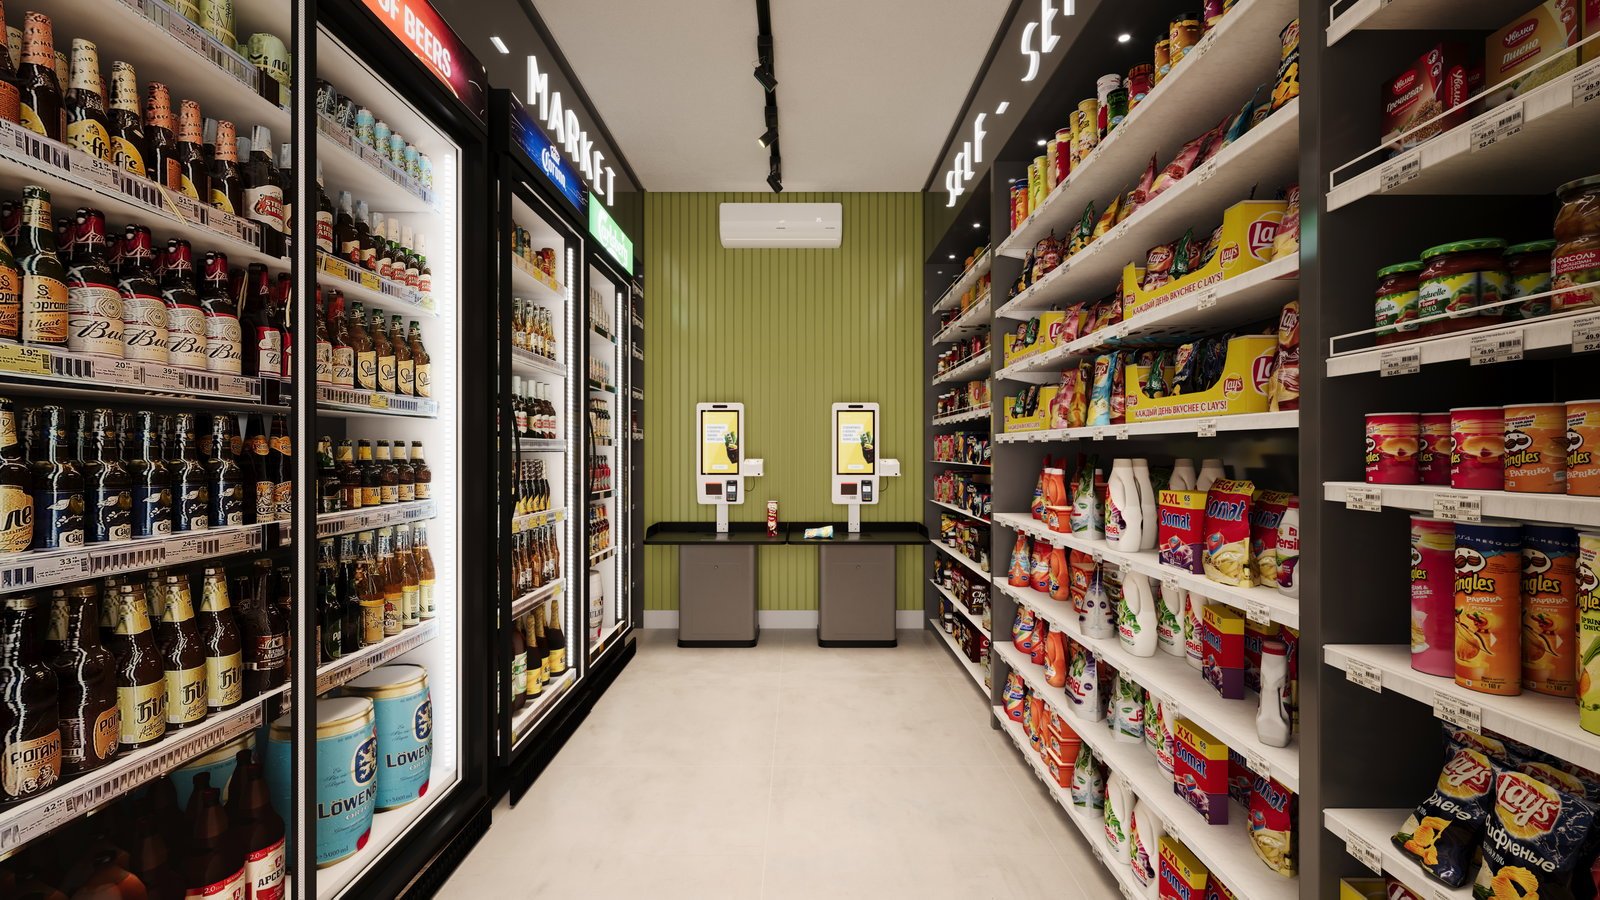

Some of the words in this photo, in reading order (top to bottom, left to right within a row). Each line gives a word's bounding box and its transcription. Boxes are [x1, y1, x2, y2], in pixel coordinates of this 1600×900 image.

[404, 4, 452, 78] BEERS
[1020, 0, 1077, 82] SE
[1504, 23, 1535, 45] Увелка
[1502, 38, 1539, 65] Пшено
[1584, 91, 1600, 102] 52.4
[526, 55, 616, 207] MARKET
[541, 146, 567, 191] Corona
[945, 112, 988, 208] SELF
[1132, 300, 1155, 315] КАЖДЫЙ
[1155, 294, 1170, 306] ДЕНЬ
[1169, 284, 1196, 302] ВКУСНЕЕ
[1584, 343, 1600, 351] 52.4
[1585, 333, 1600, 341] 49.9
[1135, 408, 1157, 418] КАЖДЫЙ
[1158, 406, 1172, 416] ДЕНЬ
[1173, 404, 1199, 414] ВКУСНЕЕ
[1162, 492, 1180, 505] XXL
[1161, 509, 1191, 531] Somat
[59, 558, 72, 566] 33
[1203, 607, 1216, 625] XXL
[1581, 615, 1600, 627] SPRIN
[1203, 621, 1222, 653] Somat
[1177, 723, 1196, 747] XXL
[1175, 740, 1207, 779] Somat
[1495, 775, 1561, 827] Lay's
[1161, 843, 1181, 871] XXL
[1161, 859, 1191, 900] Somat
